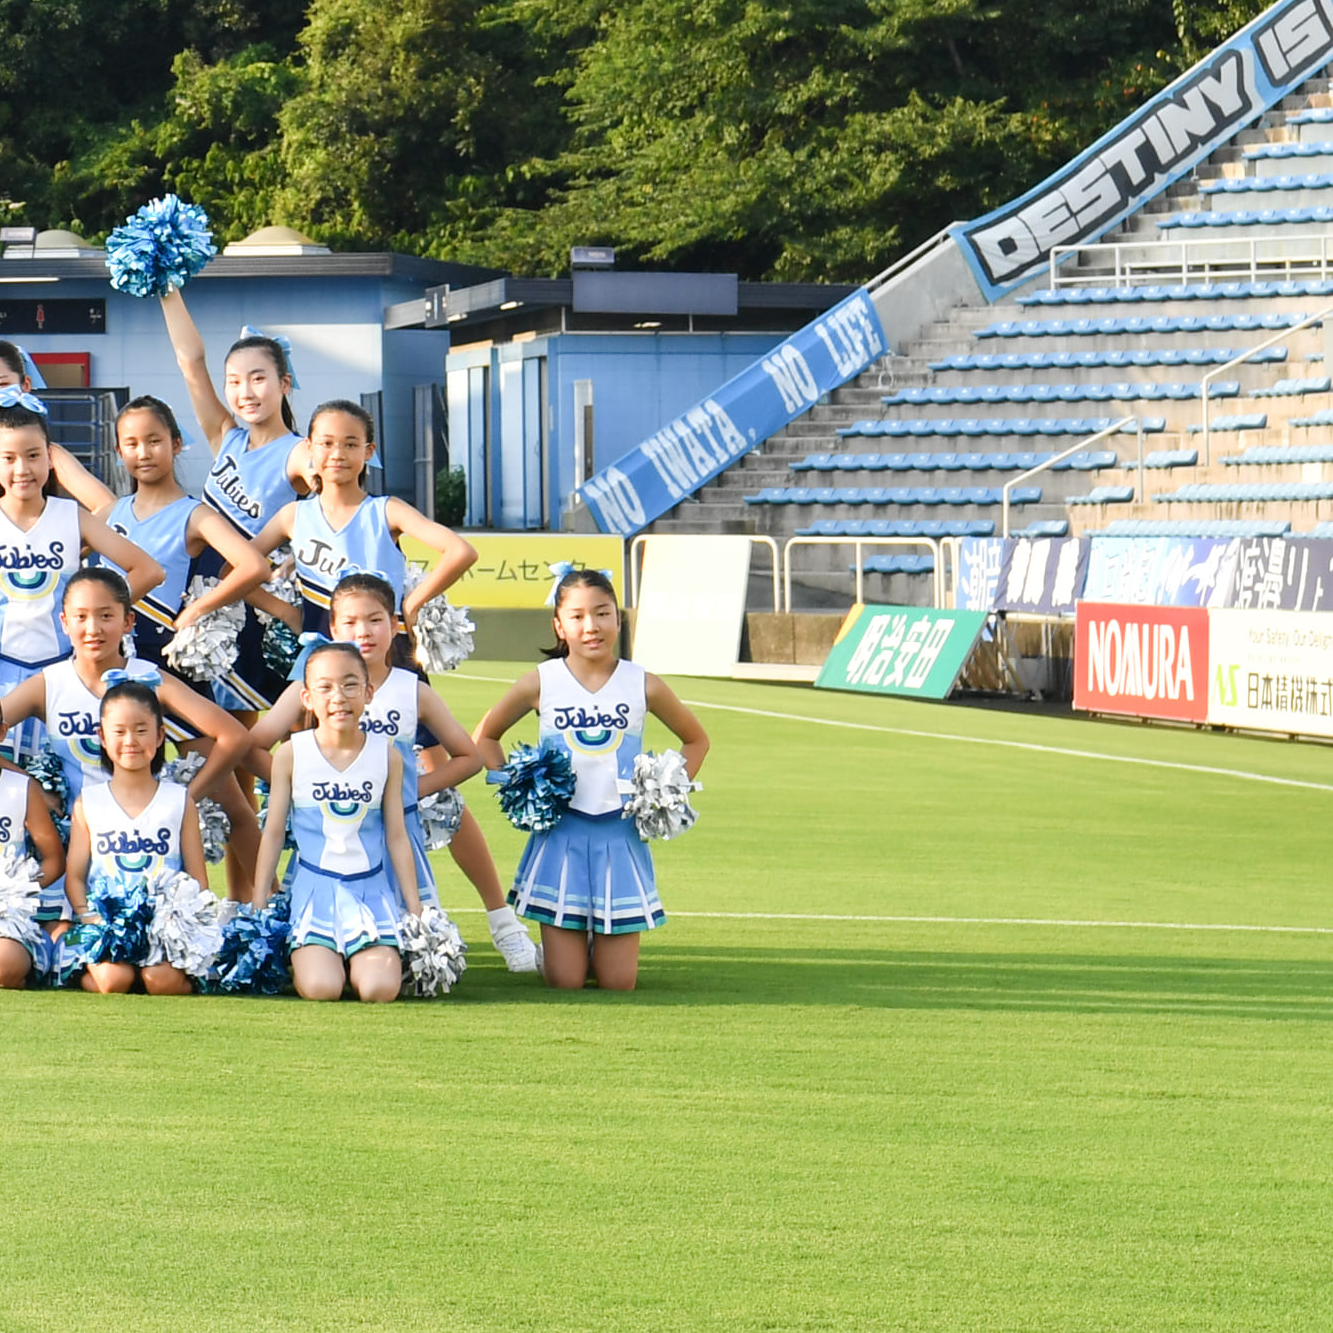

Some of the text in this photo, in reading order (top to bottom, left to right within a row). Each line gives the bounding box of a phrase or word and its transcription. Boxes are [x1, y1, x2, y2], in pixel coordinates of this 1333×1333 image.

[970, 54, 1245, 280] DESTINY
[584, 466, 646, 534] NO
[761, 344, 819, 415] NO
[814, 296, 883, 378] LIFE
[210, 454, 263, 520] Jubies
[846, 615, 955, 689] 明治安田
[1088, 619, 1194, 701] NOMURA
